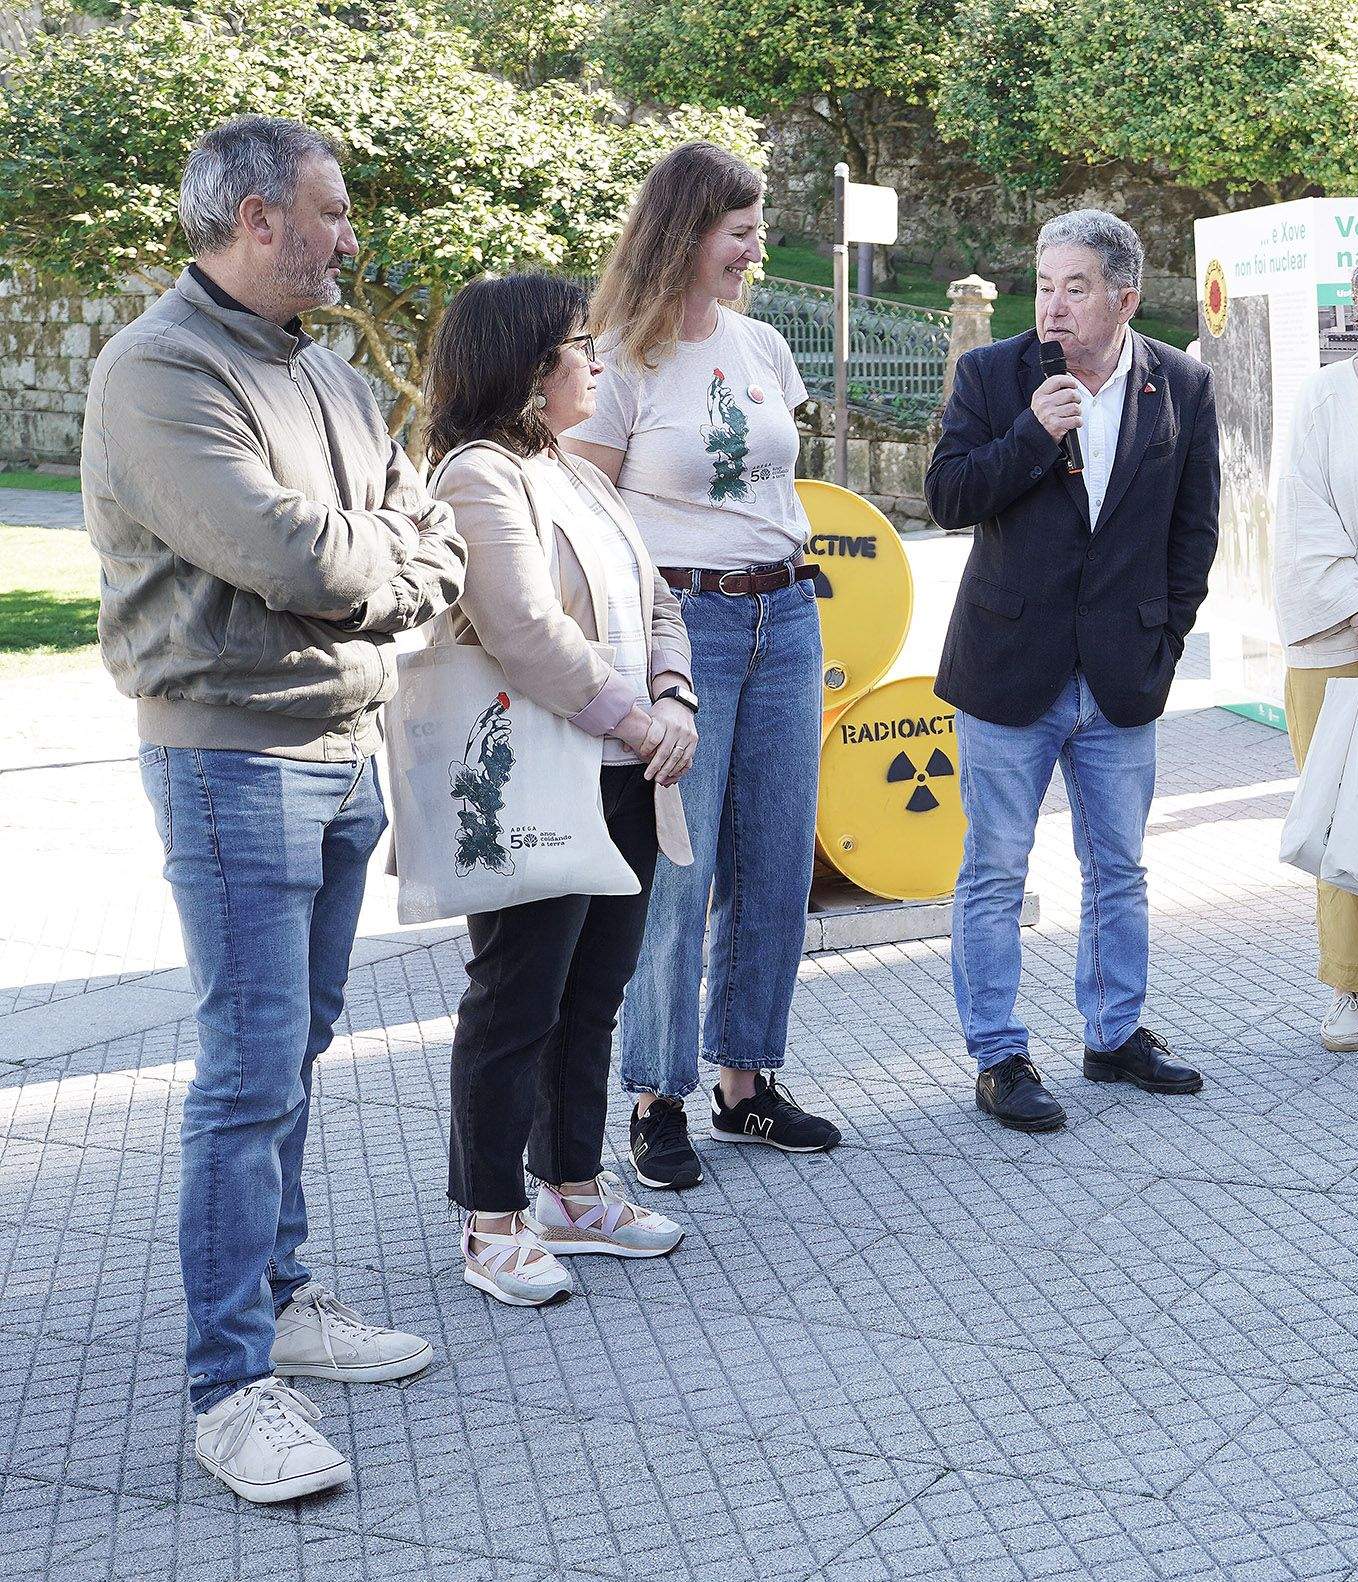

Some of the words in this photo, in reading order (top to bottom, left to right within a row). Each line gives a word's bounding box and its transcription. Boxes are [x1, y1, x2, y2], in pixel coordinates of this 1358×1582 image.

[1272, 229, 1278, 243] e
[1281, 222, 1306, 242] Xove
[1235, 262, 1252, 277] non
[1254, 254, 1266, 274] foi
[1269, 250, 1307, 273] nuclear
[841, 714, 955, 744] RADIOACT
